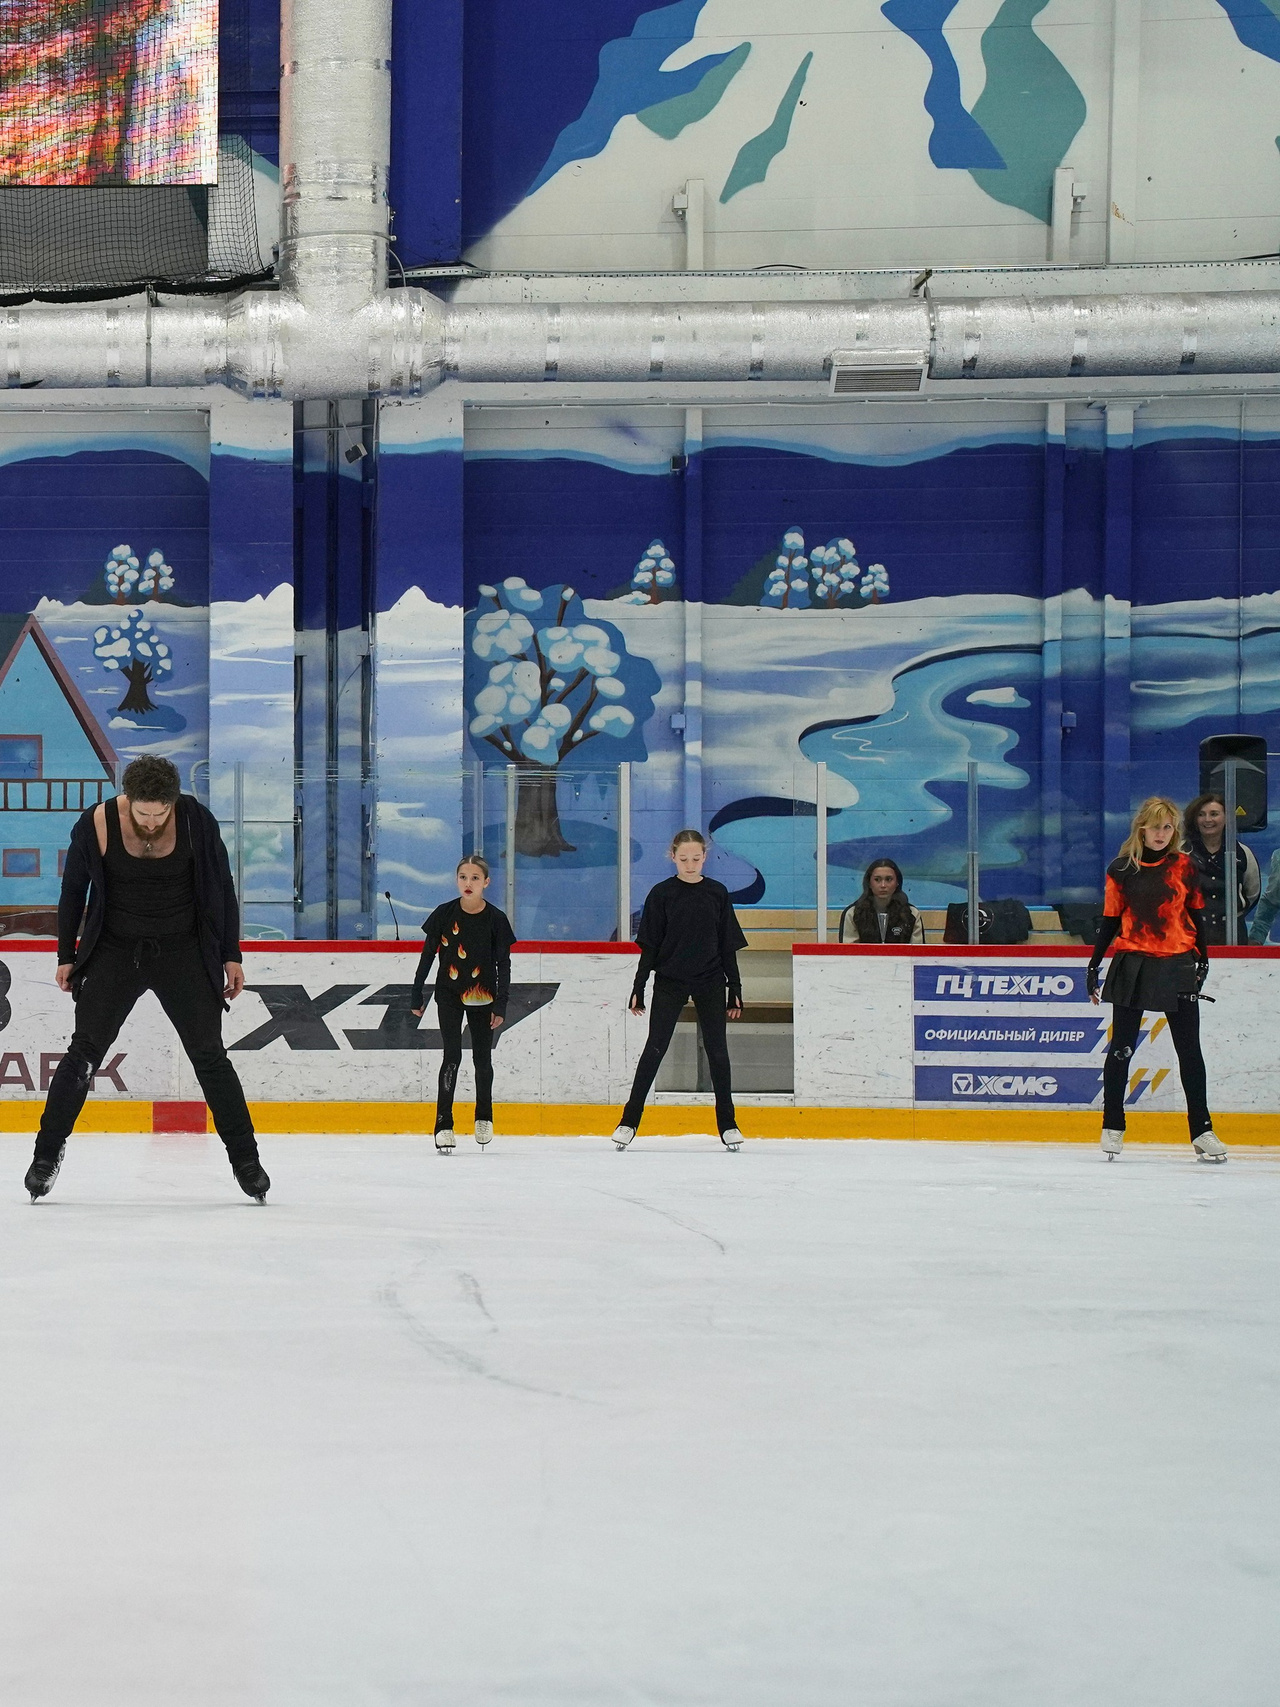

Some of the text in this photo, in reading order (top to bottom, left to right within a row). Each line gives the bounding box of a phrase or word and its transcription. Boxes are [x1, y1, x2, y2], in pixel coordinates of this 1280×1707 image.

[936, 975, 1074, 998] ГЦ ТЕХНО
[924, 1027, 1085, 1043] ОФИЦИАЛЬНЫЙ ДИЛЕР
[973, 1075, 1058, 1096] XCMG
